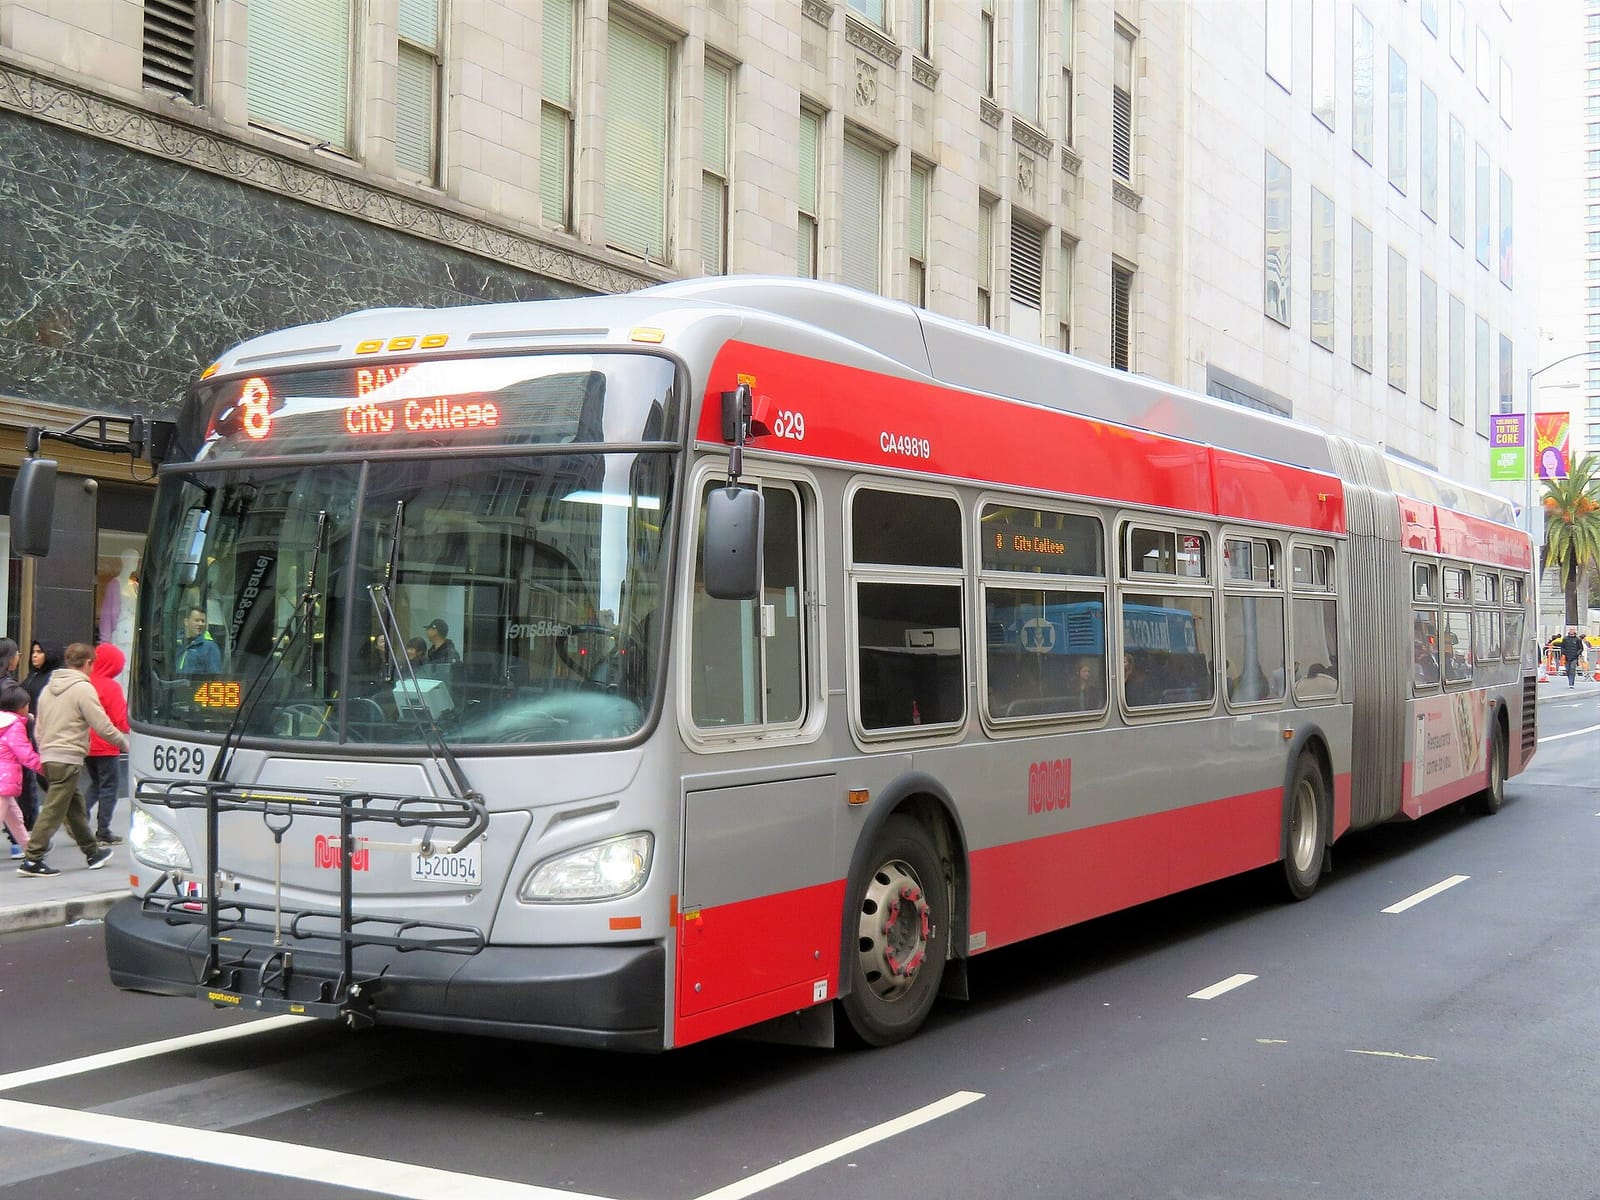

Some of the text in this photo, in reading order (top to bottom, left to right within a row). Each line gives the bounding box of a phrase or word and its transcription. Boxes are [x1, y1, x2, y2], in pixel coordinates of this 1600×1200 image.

[241, 377, 271, 439] 8
[345, 399, 498, 433] City College
[1496, 425, 1519, 433] TO THE
[1496, 433, 1519, 444] CORE
[880, 431, 930, 459] CA49819
[995, 533, 1065, 554] 8 City College
[194, 681, 240, 707] 498
[153, 745, 205, 775] 6629
[415, 855, 476, 879] 1520054
